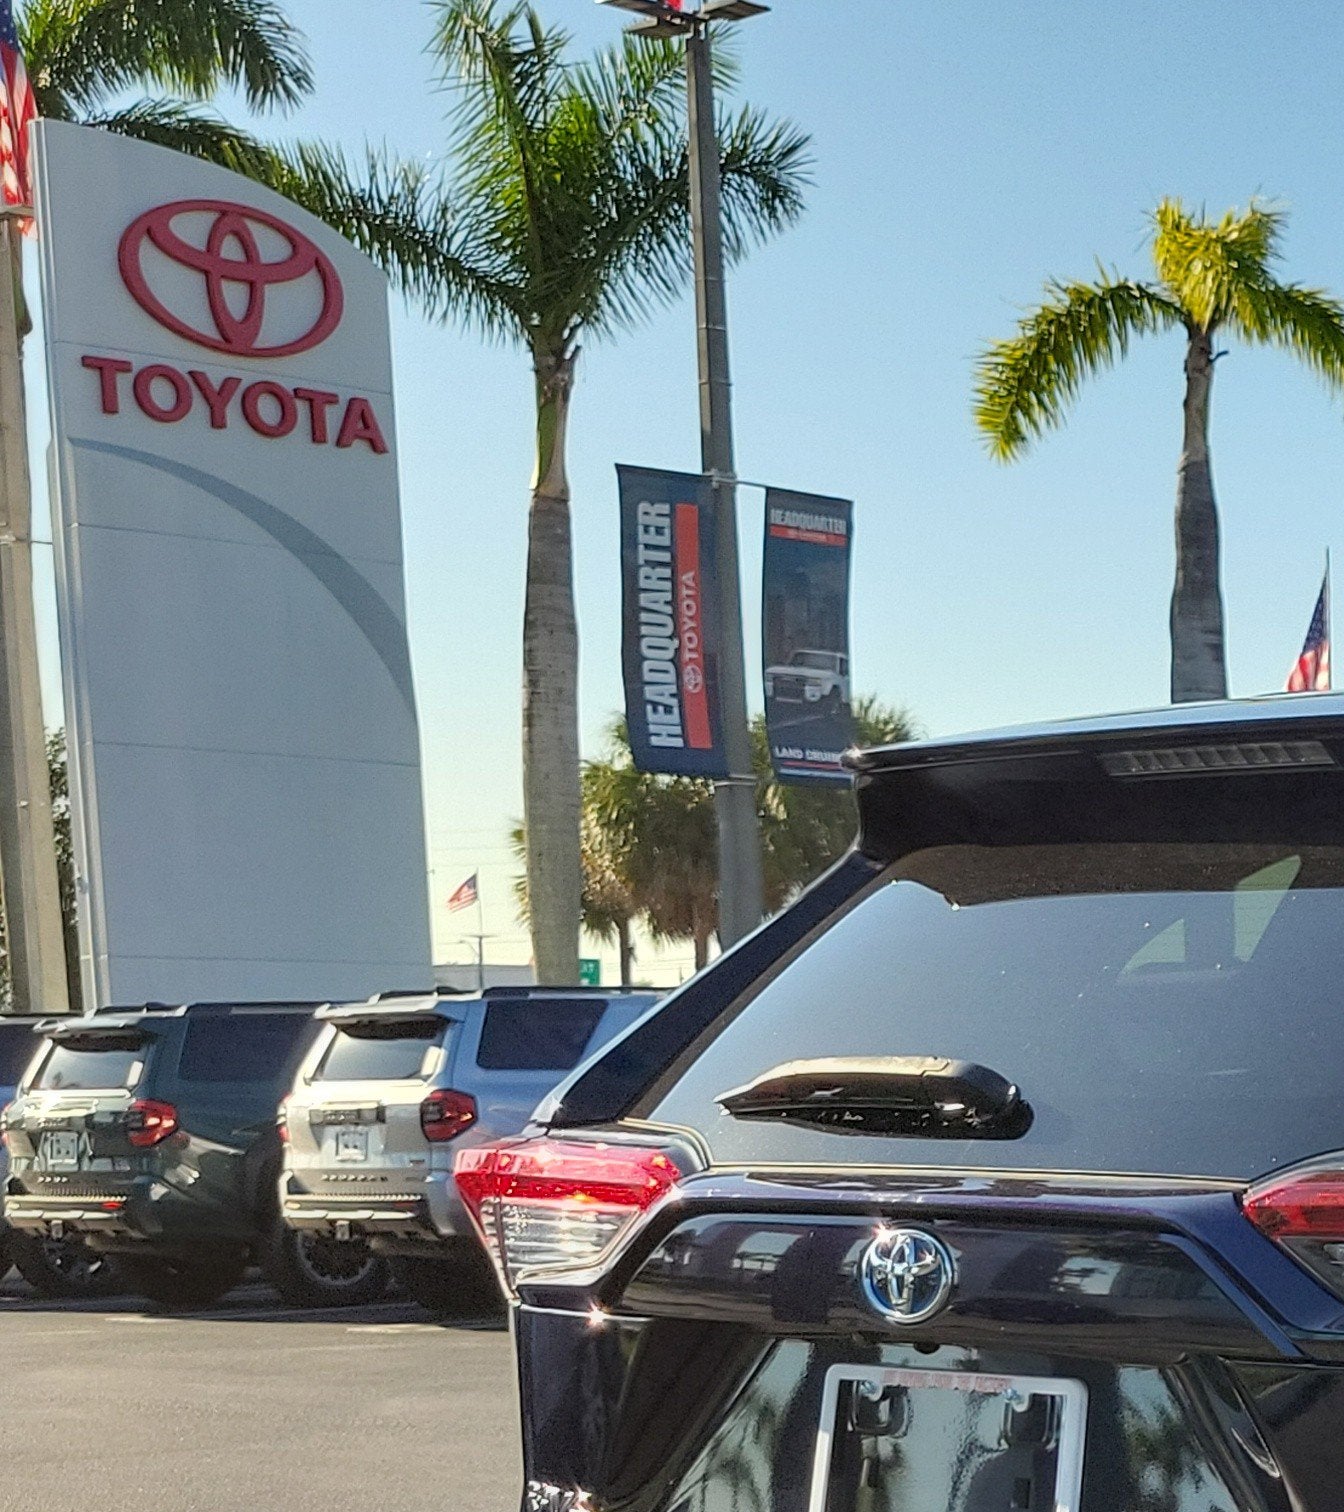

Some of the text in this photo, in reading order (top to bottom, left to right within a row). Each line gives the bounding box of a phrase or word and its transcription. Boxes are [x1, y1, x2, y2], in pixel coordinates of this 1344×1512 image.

[81, 355, 389, 454] TOYOTA
[638, 500, 684, 748] HEADQUARTER
[681, 571, 703, 662] TOYOTA
